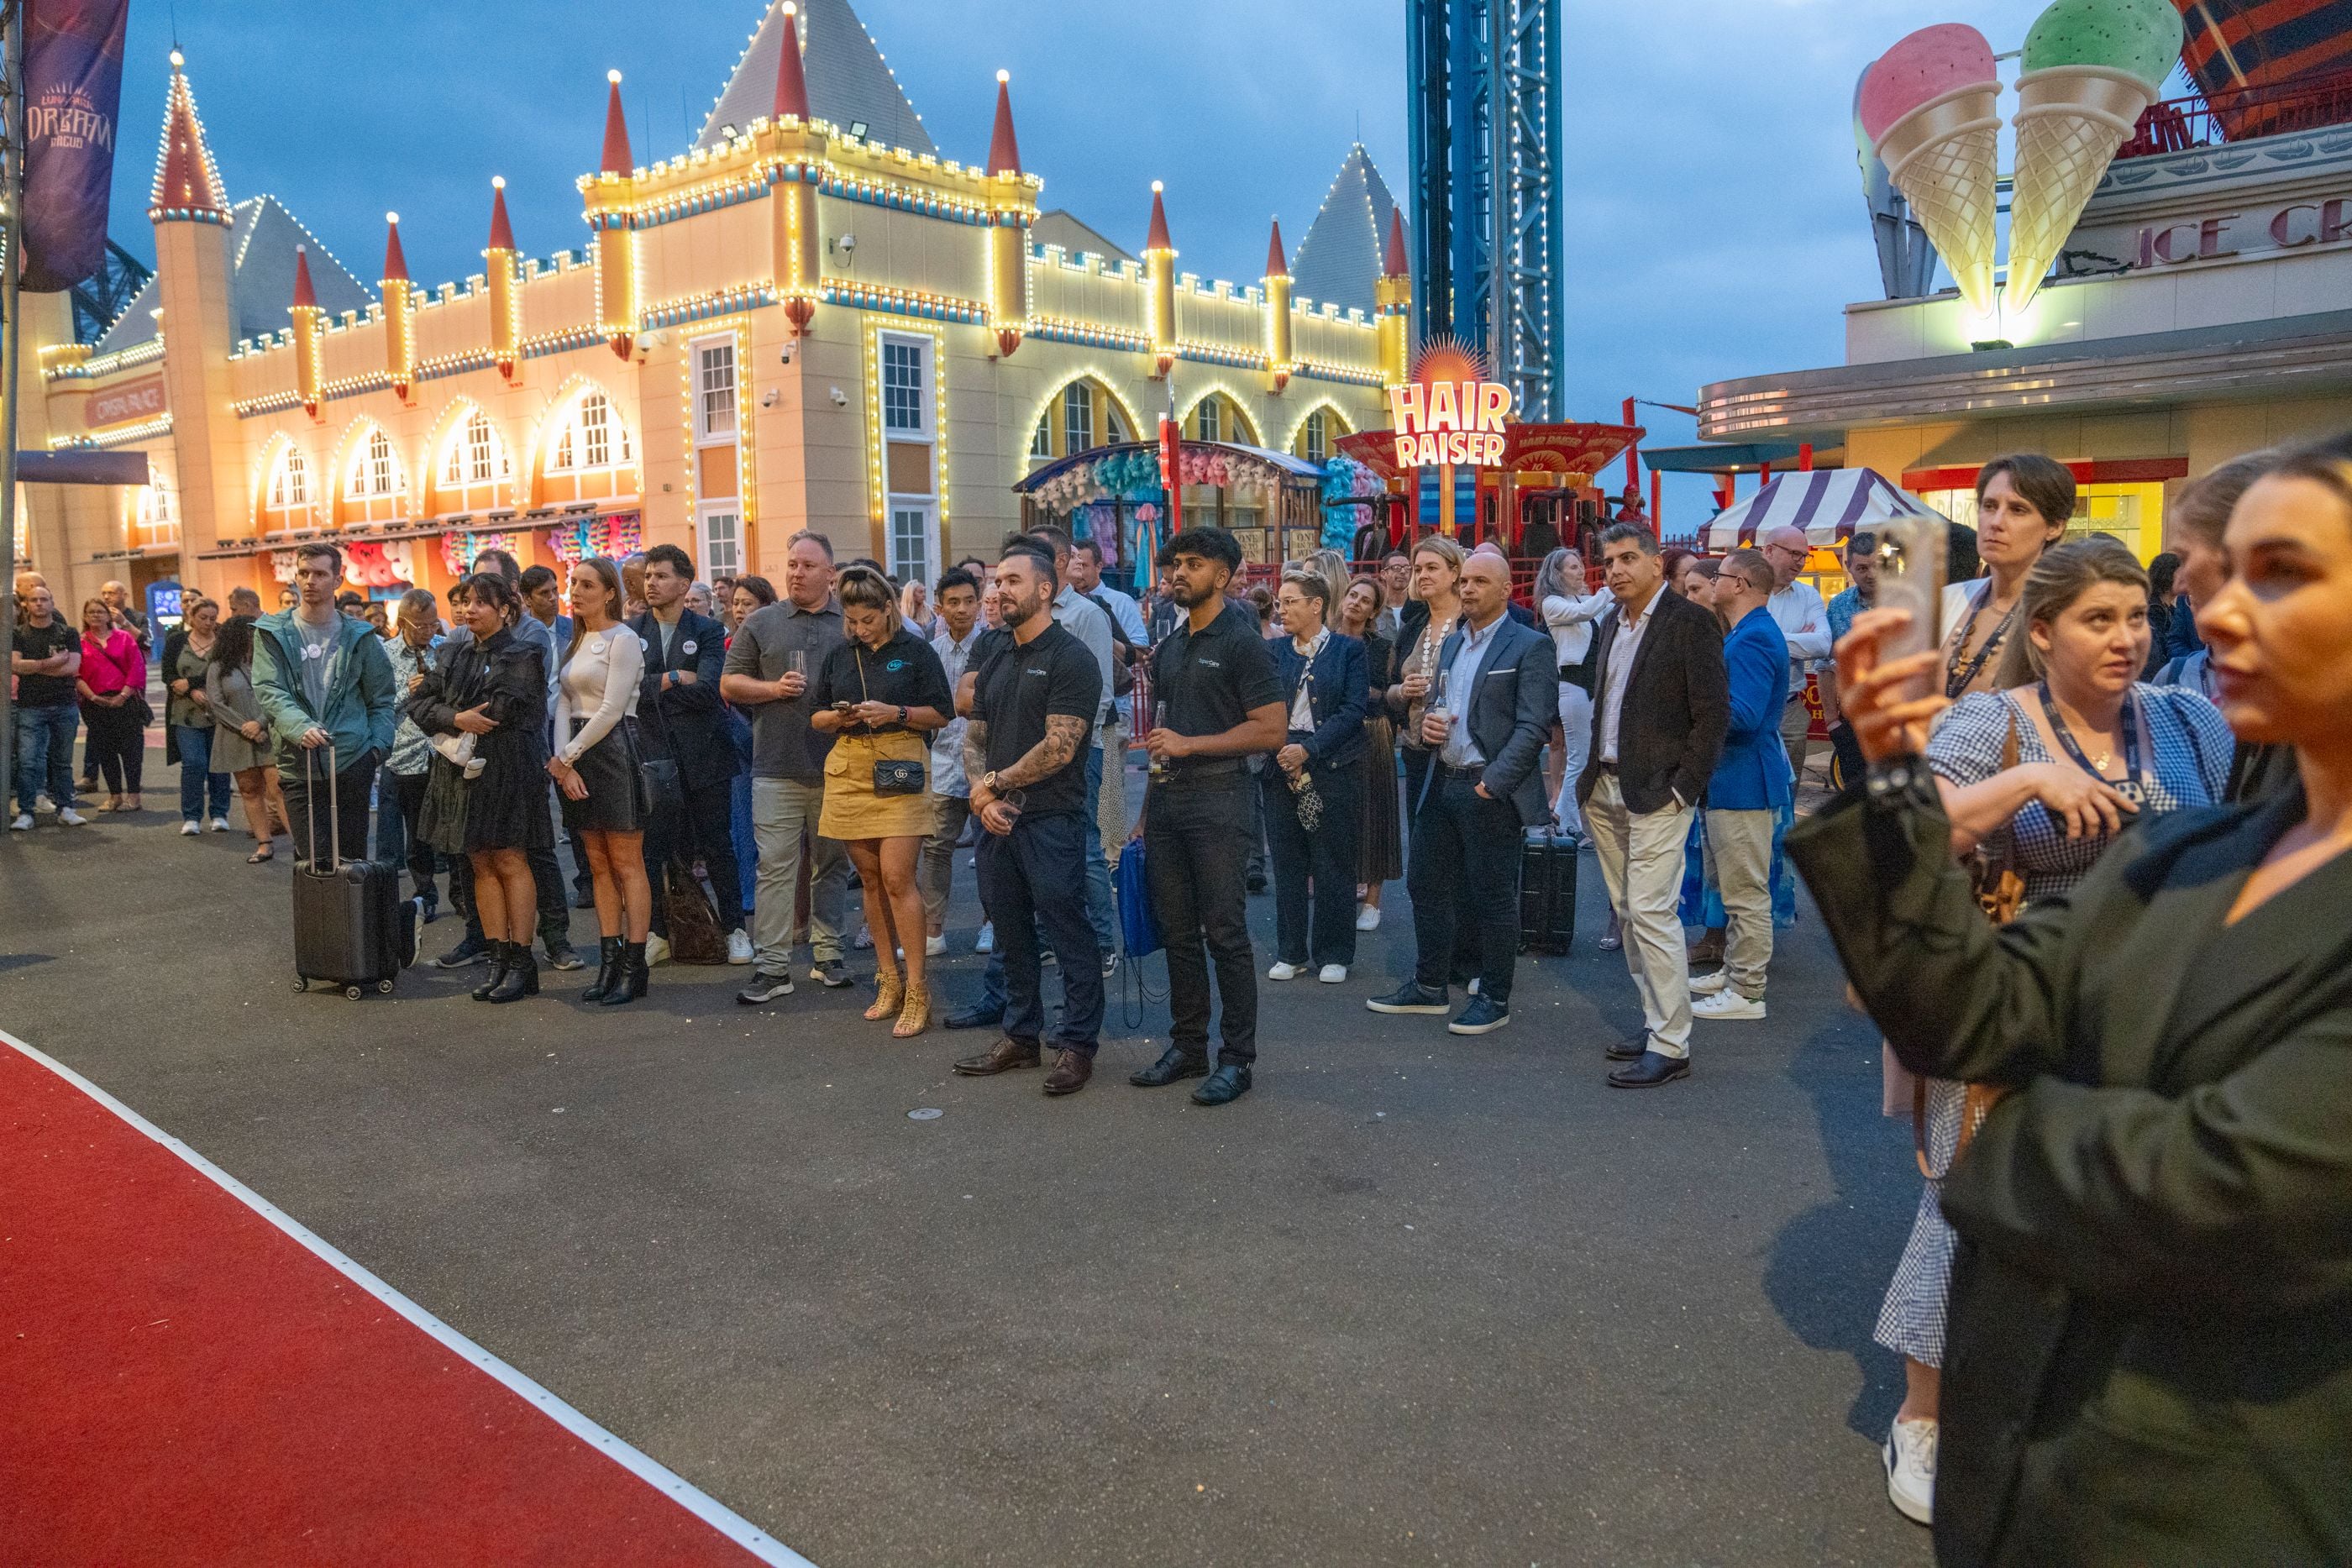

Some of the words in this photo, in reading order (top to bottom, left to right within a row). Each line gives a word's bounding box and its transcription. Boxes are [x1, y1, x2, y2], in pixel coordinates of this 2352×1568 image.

[2134, 213, 2241, 270] ICE
[1389, 381, 1512, 435] HAIR
[1395, 433, 1505, 468] RAISER
